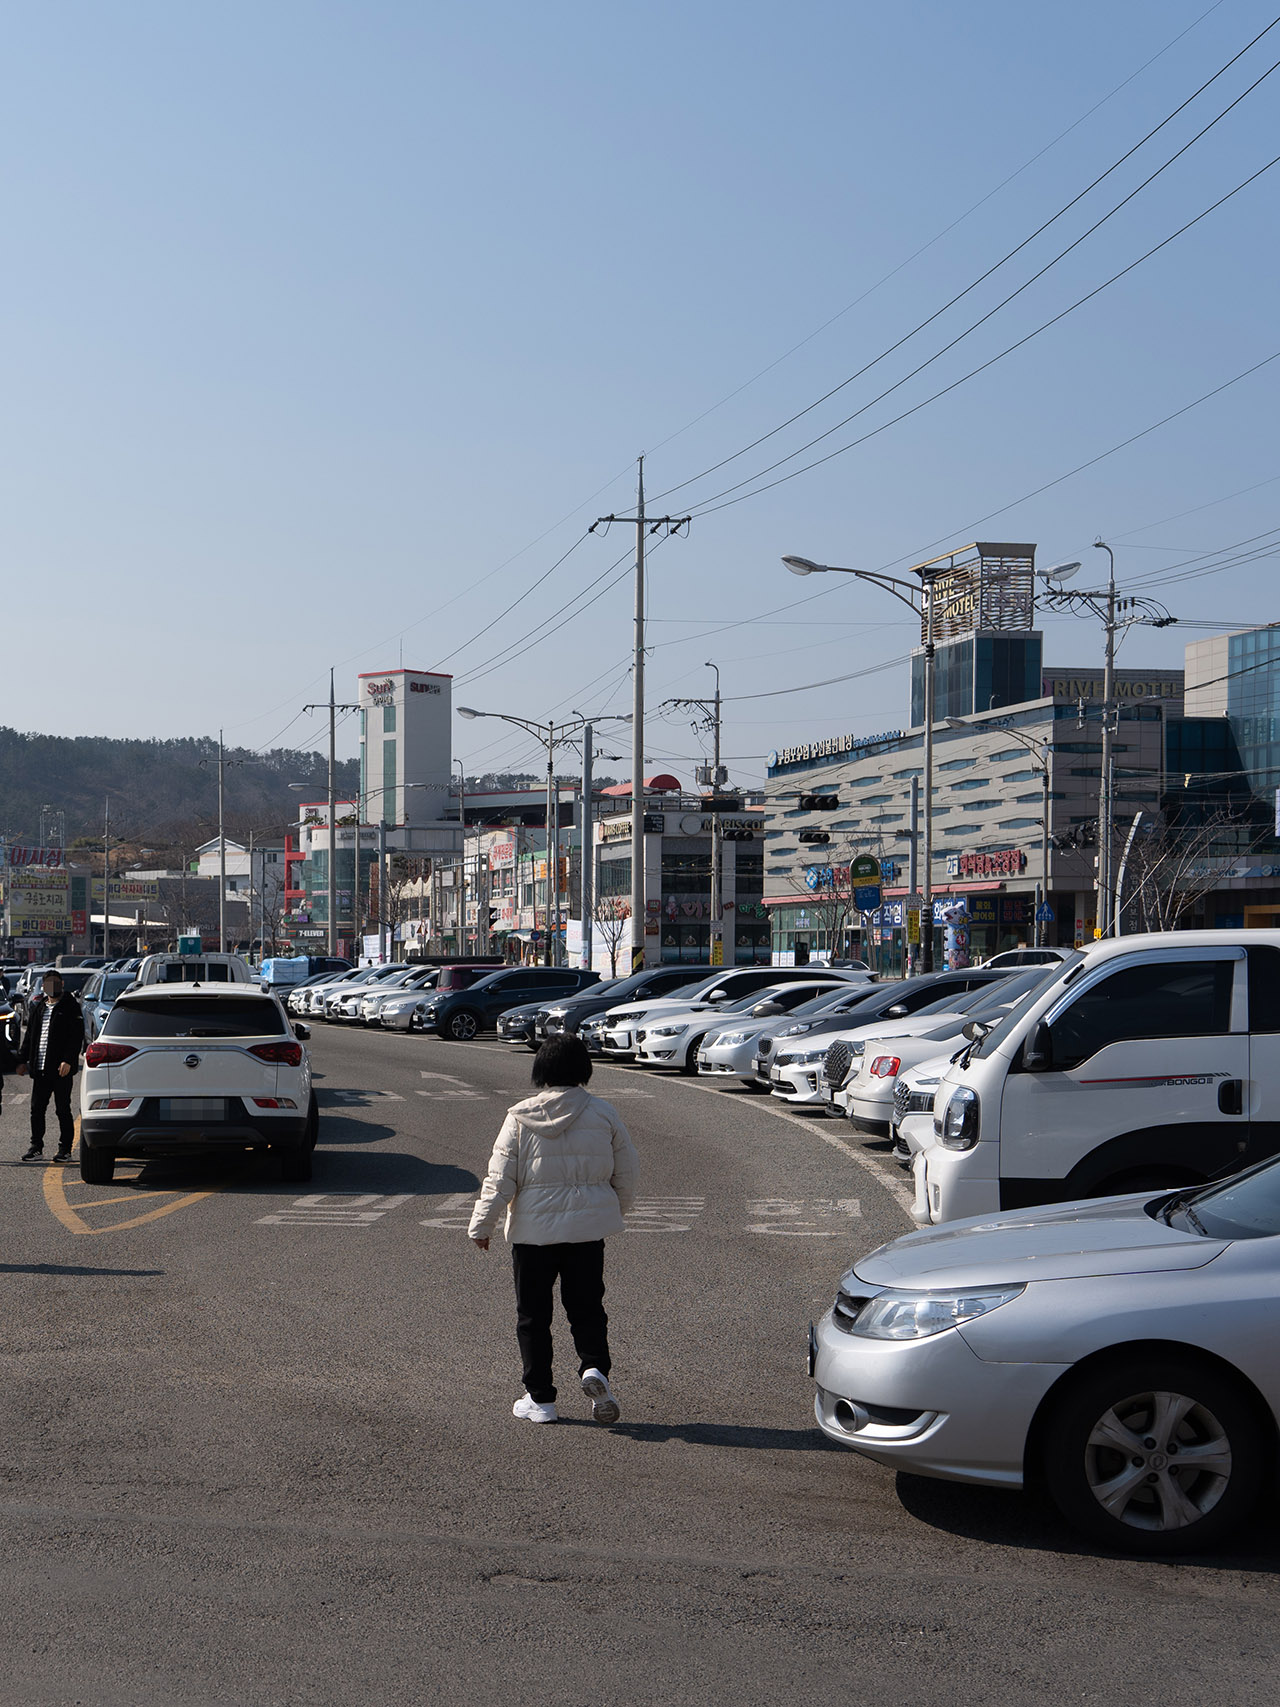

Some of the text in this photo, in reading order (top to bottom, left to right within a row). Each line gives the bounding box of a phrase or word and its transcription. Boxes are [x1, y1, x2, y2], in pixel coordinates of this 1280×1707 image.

[943, 593, 975, 619] MOTEL
[1115, 681, 1183, 698] MOTEL
[23, 920, 72, 930] 바다할인마트
[1167, 1078, 1206, 1086] BONGO
